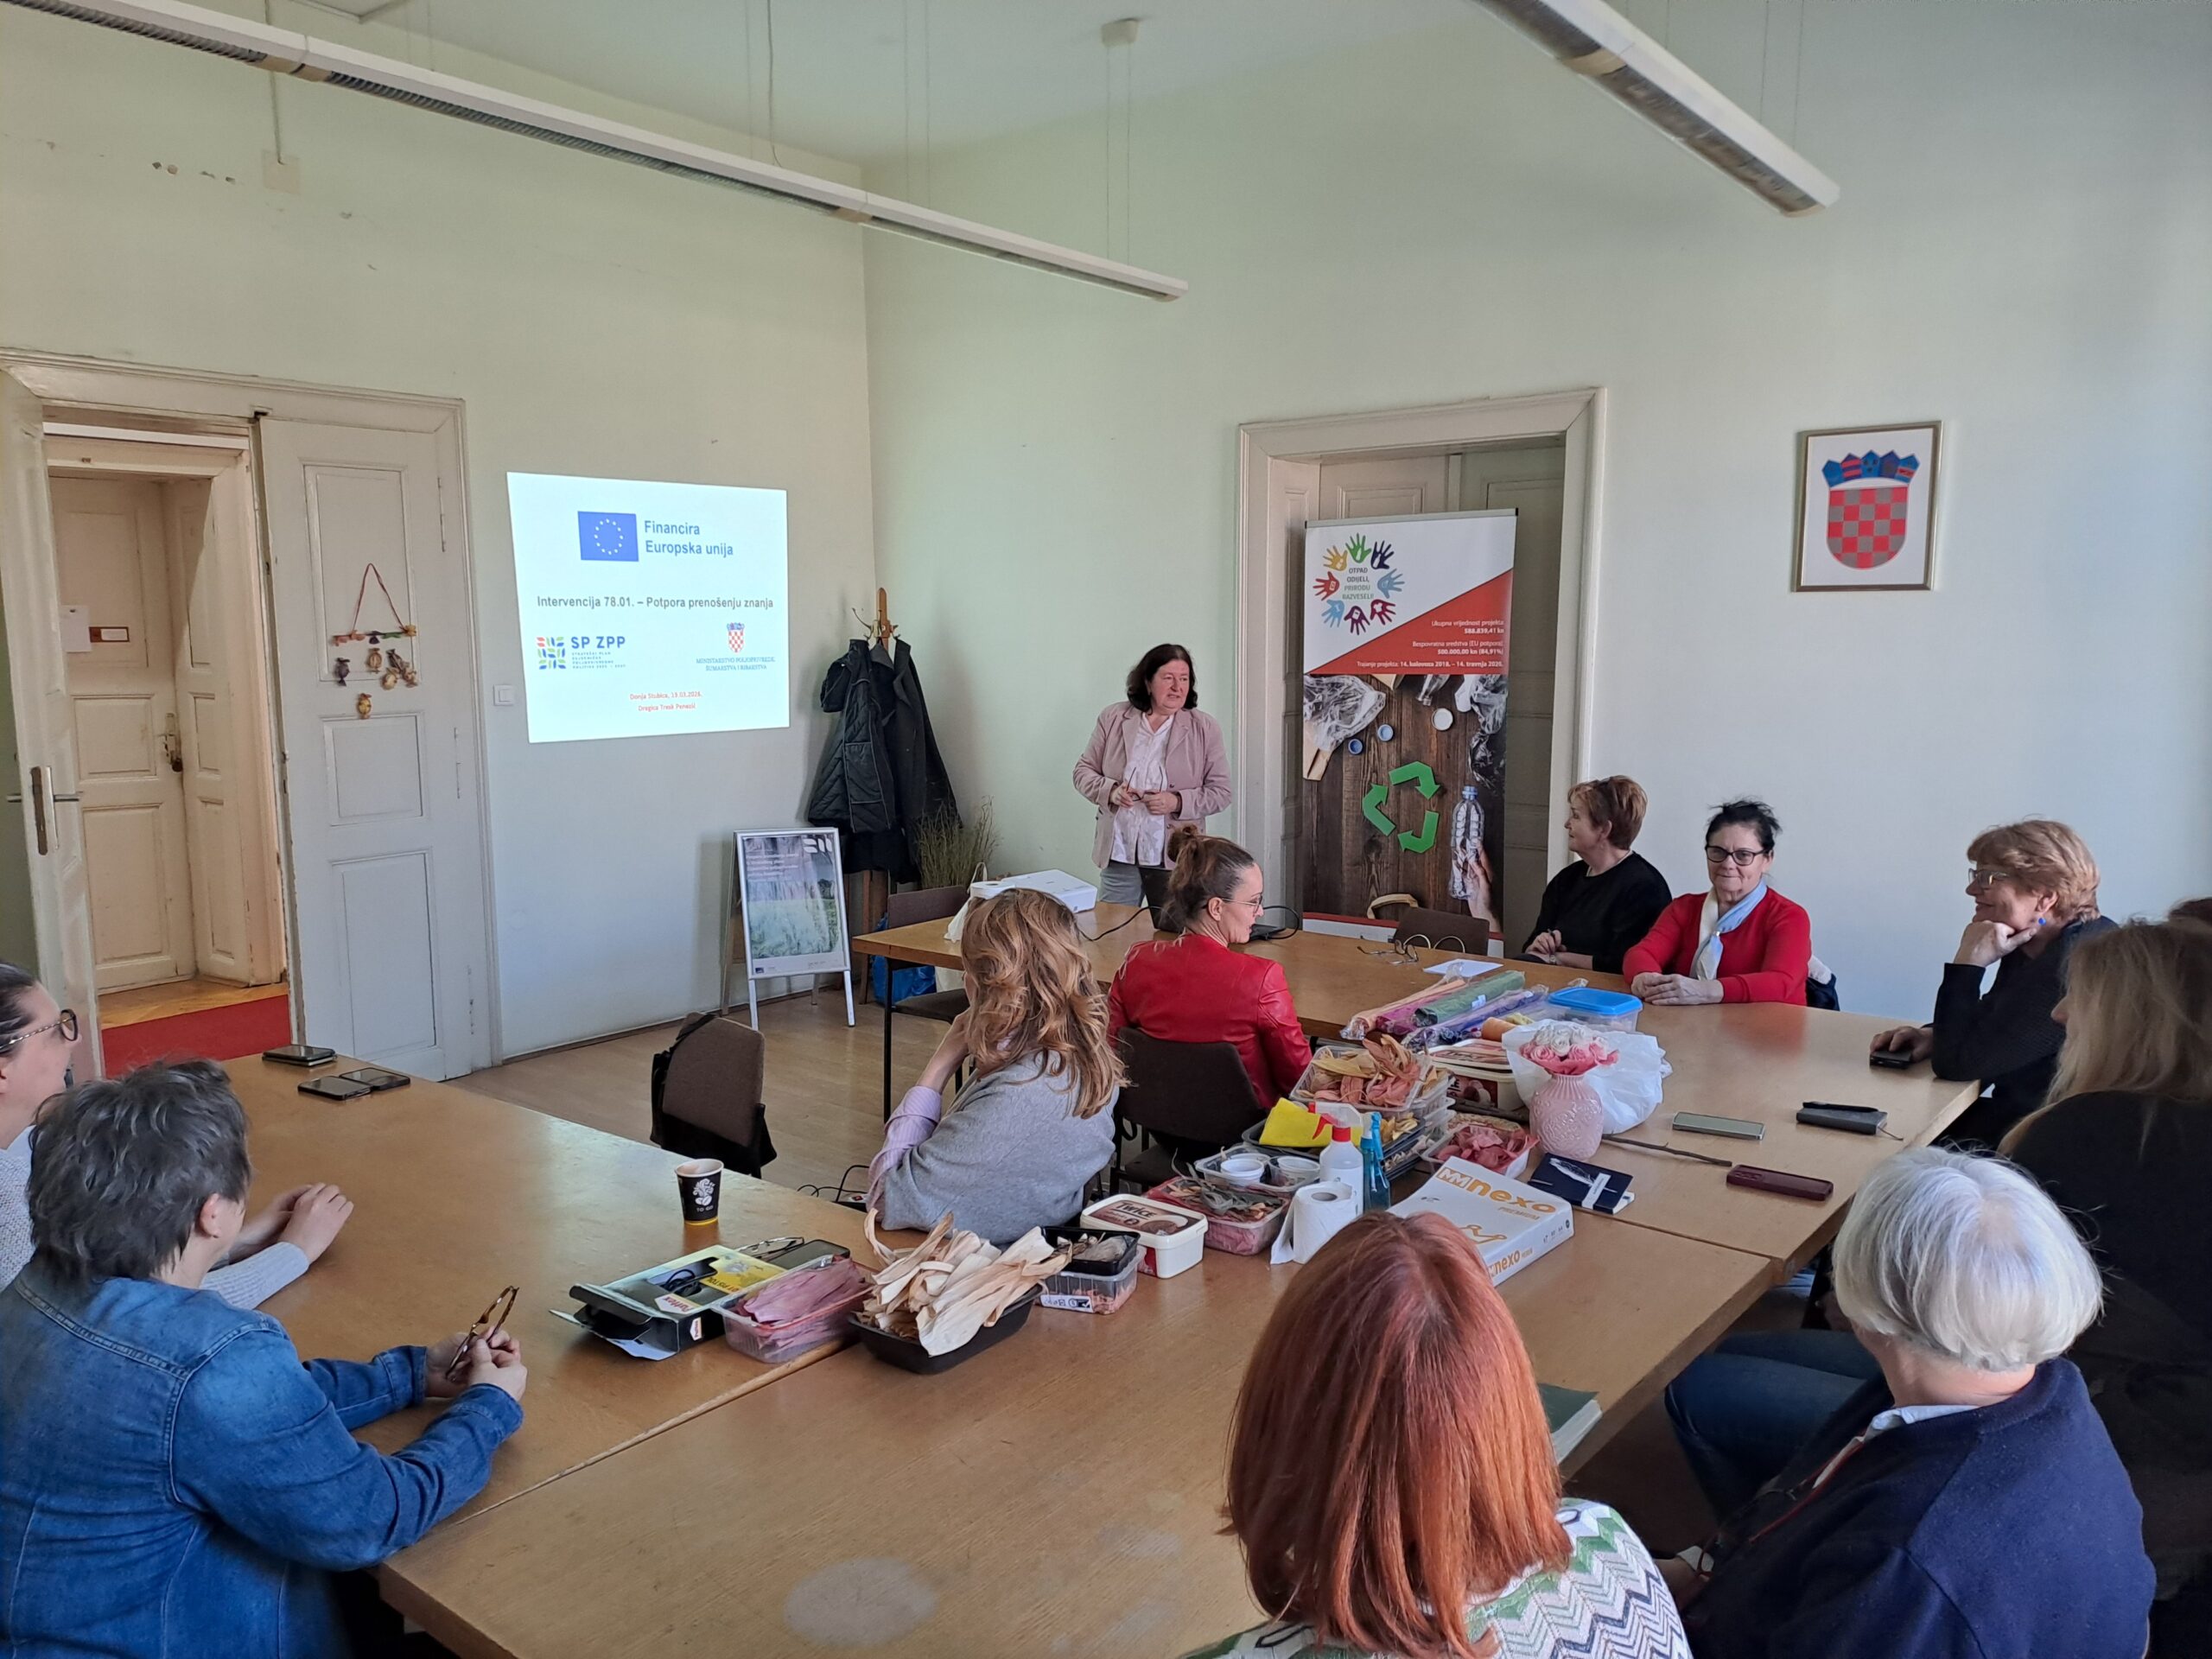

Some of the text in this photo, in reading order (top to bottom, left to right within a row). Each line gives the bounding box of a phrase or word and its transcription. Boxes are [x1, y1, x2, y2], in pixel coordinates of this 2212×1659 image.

[645, 520, 700, 535] Financira
[645, 540, 734, 558] Europska unija
[537, 595, 601, 610] Intervencija
[604, 596, 634, 607] 78.01.
[646, 597, 685, 609] Potpora
[688, 597, 741, 610] prenošenju
[744, 597, 773, 610] znanja
[571, 636, 626, 649] SP ZPP
[1466, 1179, 1556, 1213] nexo
